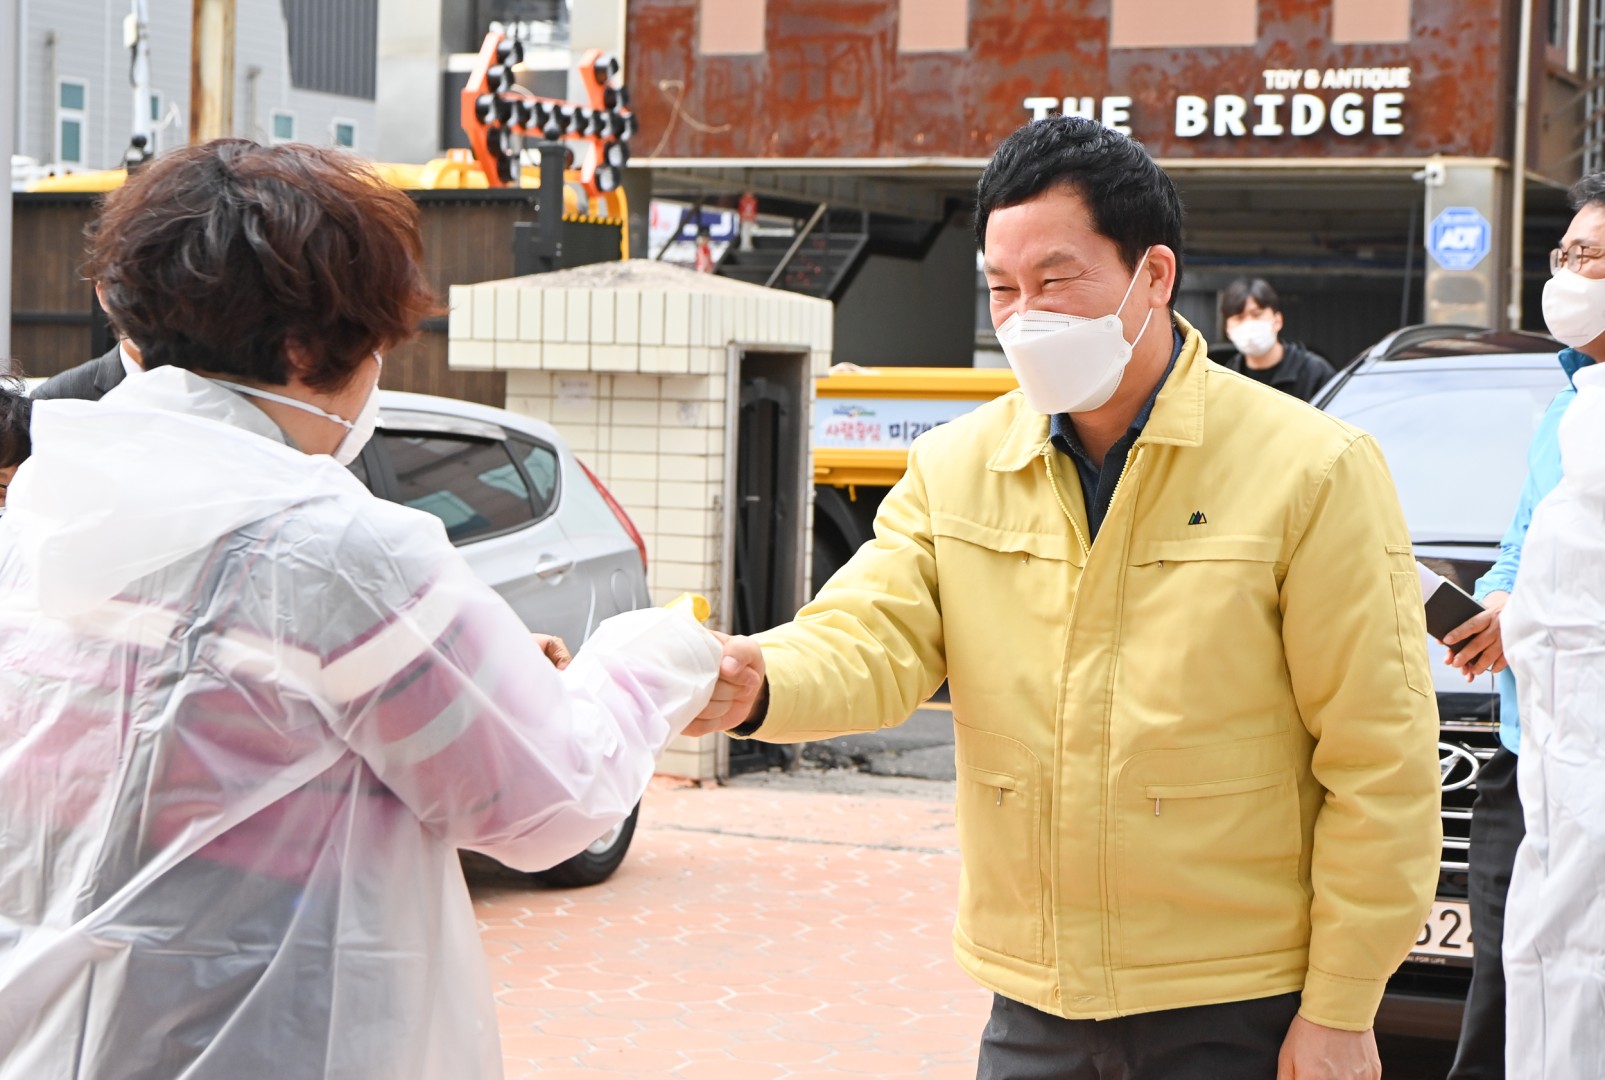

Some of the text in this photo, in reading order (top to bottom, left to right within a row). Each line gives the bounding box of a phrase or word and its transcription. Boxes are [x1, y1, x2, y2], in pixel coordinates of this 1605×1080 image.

[1263, 69, 1302, 90] TOY
[1322, 67, 1412, 91] ANTIQUE
[1175, 92, 1405, 137] BRIDGE
